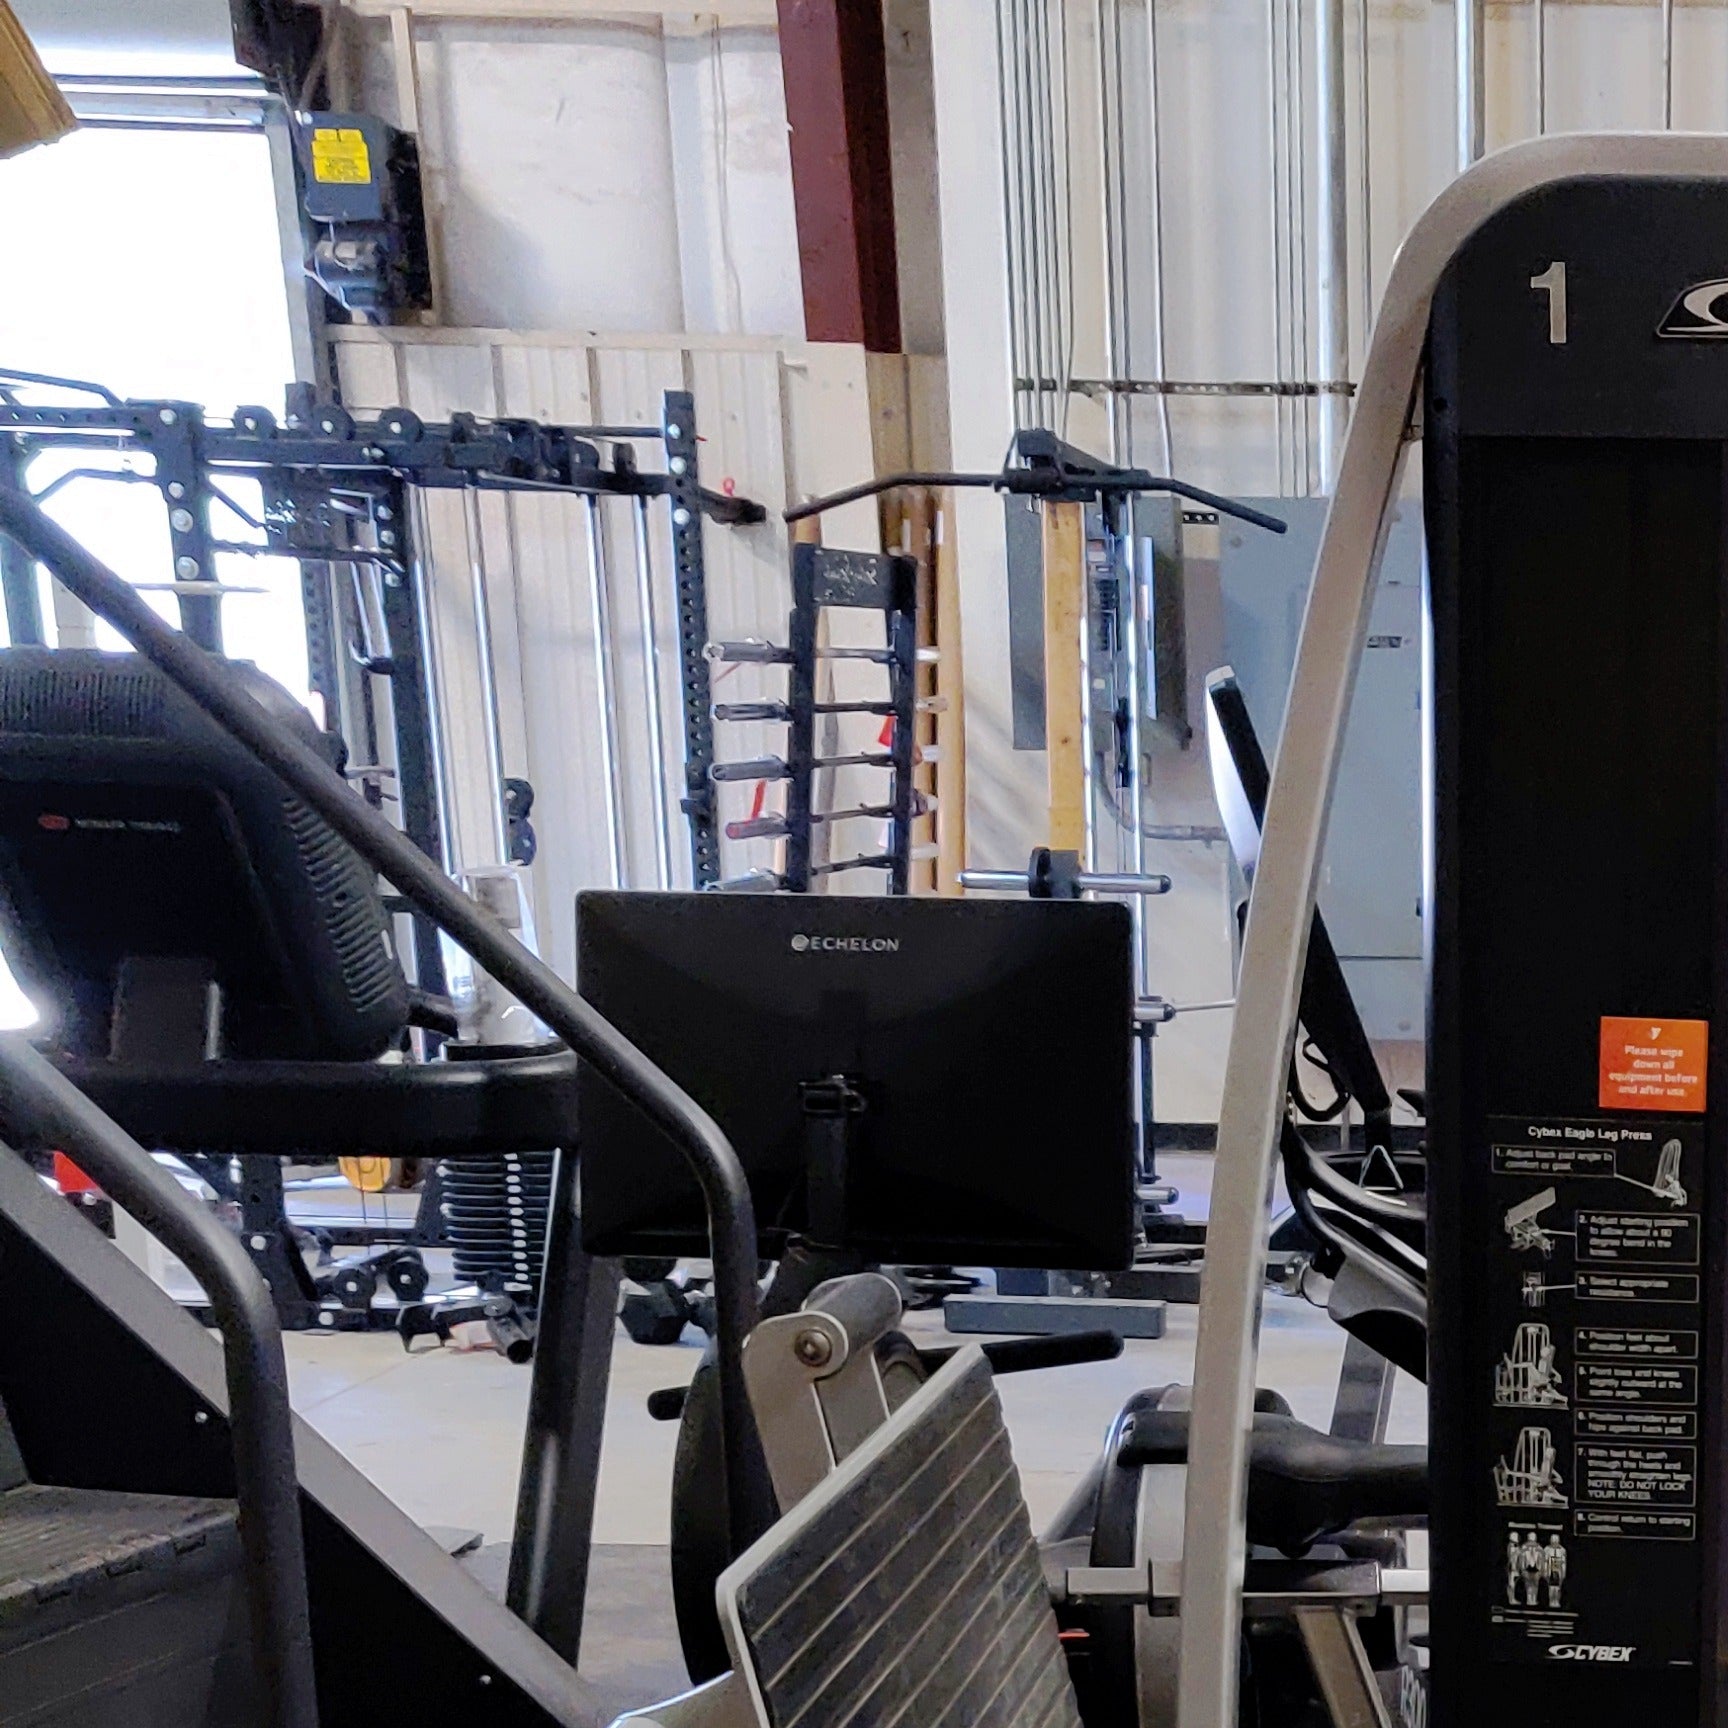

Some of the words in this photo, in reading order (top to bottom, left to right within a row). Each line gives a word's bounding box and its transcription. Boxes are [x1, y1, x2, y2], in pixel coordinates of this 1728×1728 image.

[1530, 261, 1566, 344] 1
[810, 936, 899, 952] ECHELON
[1664, 1074, 1697, 1083] before
[1528, 1126, 1562, 1139] Cybex
[1565, 1127, 1595, 1141] Eagle
[1598, 1128, 1618, 1142] Leg
[1621, 1129, 1652, 1141] Press
[1637, 1481, 1657, 1490] NOT
[1659, 1482, 1686, 1491] LOCK
[1574, 1645, 1636, 1662] CYBEX
